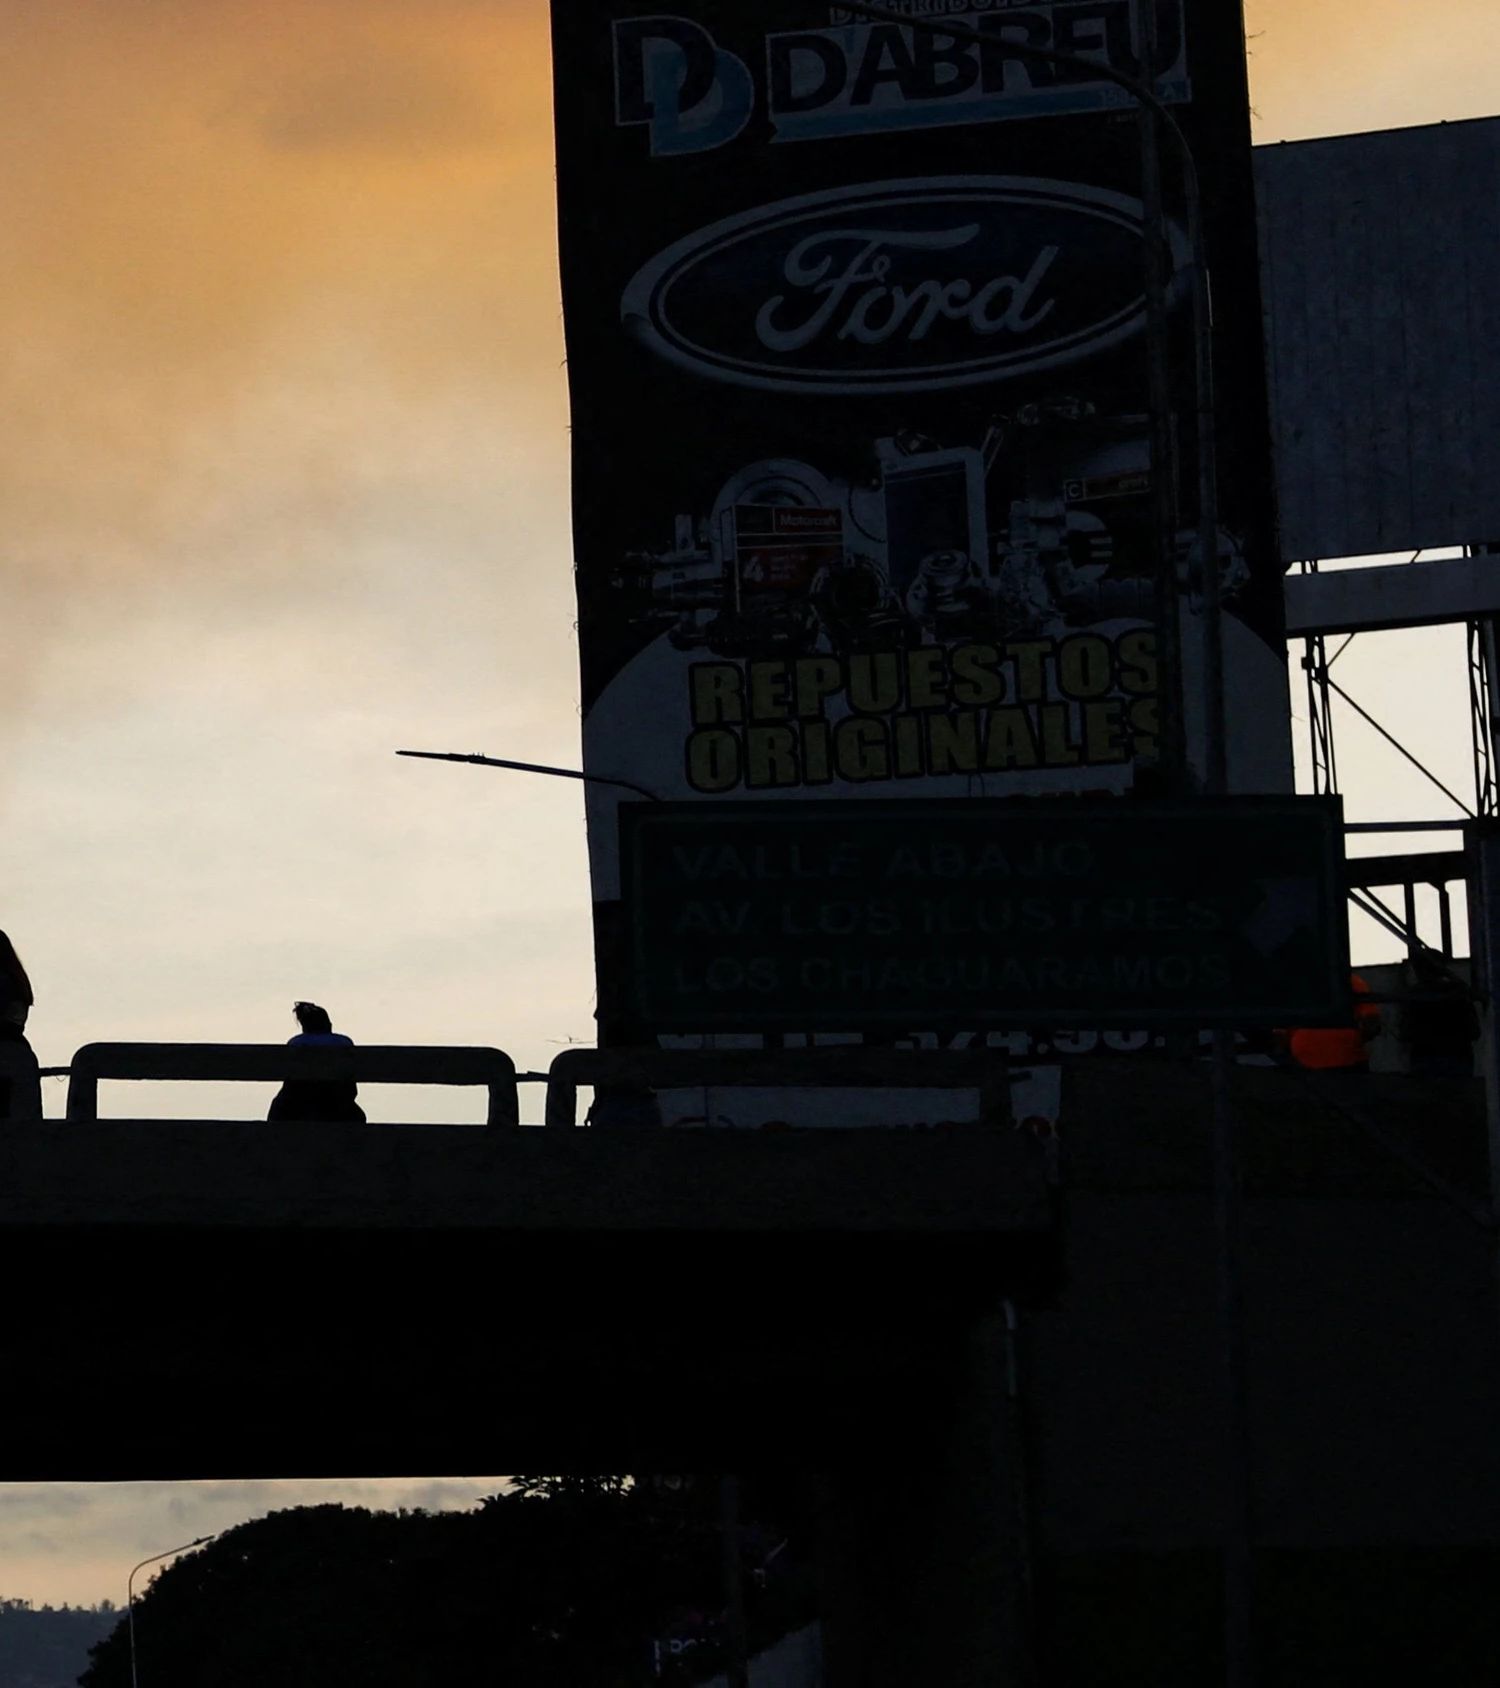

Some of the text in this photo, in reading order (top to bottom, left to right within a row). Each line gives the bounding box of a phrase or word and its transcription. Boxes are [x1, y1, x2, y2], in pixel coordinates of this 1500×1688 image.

[754, 222, 1059, 352] Ford
[689, 629, 1158, 725] REPUESTOS
[672, 839, 1097, 882] VALLE ABAJO
[780, 898, 900, 938] LOS
[922, 896, 1224, 934] ILUSTRES
[672, 954, 1231, 995] LOS CHAGUARAMOS
